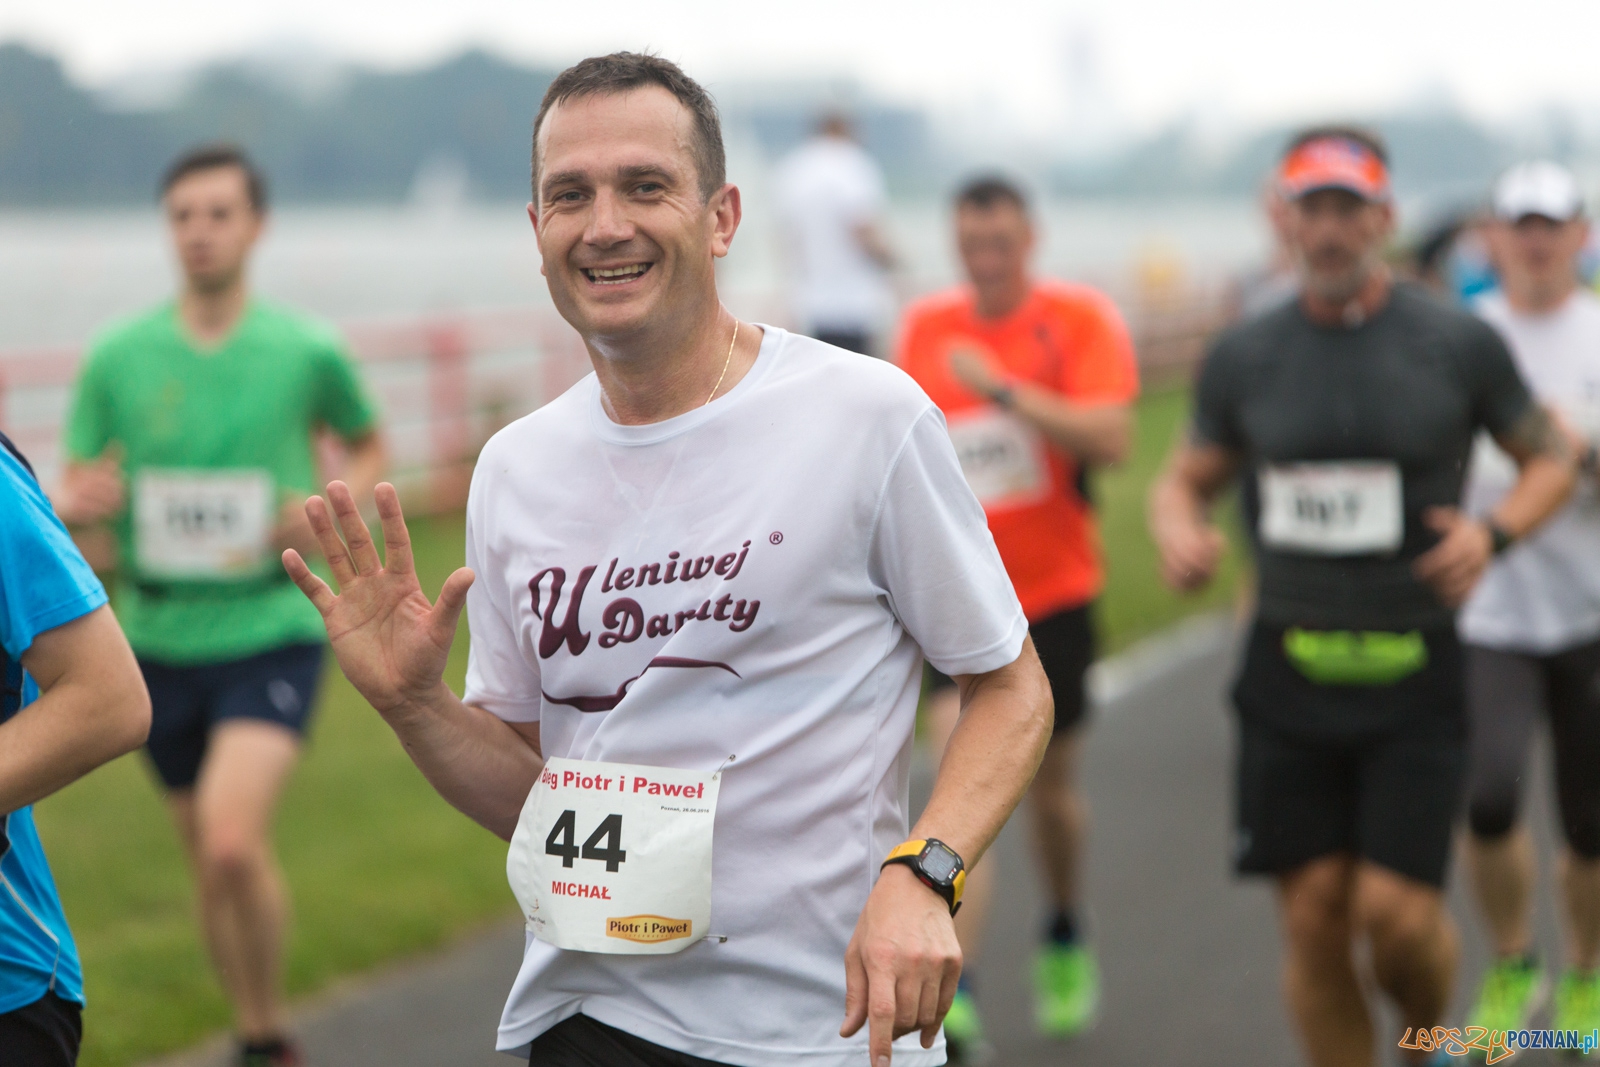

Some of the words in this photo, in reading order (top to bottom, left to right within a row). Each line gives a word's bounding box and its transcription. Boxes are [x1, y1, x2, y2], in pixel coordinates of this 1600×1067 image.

[601, 539, 751, 594] leniwej
[563, 770, 612, 791] Piotr
[619, 775, 625, 792] i
[633, 776, 704, 799] Paweł
[545, 809, 627, 873] 44
[551, 880, 612, 900] MICHAŁ
[609, 920, 640, 933] Piotr
[643, 922, 648, 933] i
[652, 922, 688, 934] Paweł
